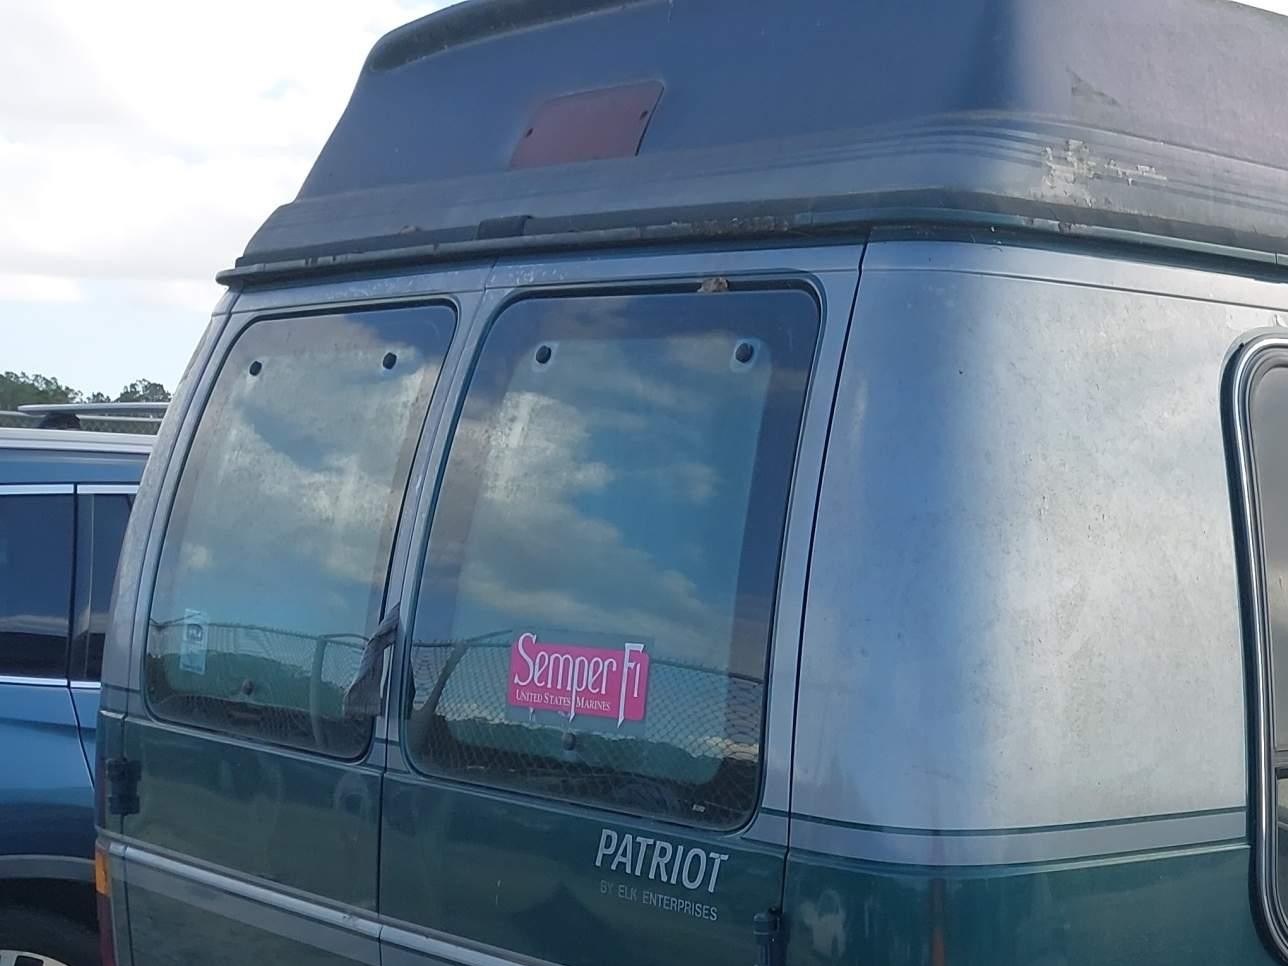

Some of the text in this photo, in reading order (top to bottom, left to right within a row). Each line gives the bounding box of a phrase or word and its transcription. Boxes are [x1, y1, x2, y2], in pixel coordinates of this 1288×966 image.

[514, 632, 617, 723] Semper
[516, 689, 611, 711] UNITED STATES MARINES
[595, 828, 729, 893] PATRIOT
[600, 880, 718, 921] BY ELK ENTERPRISES
